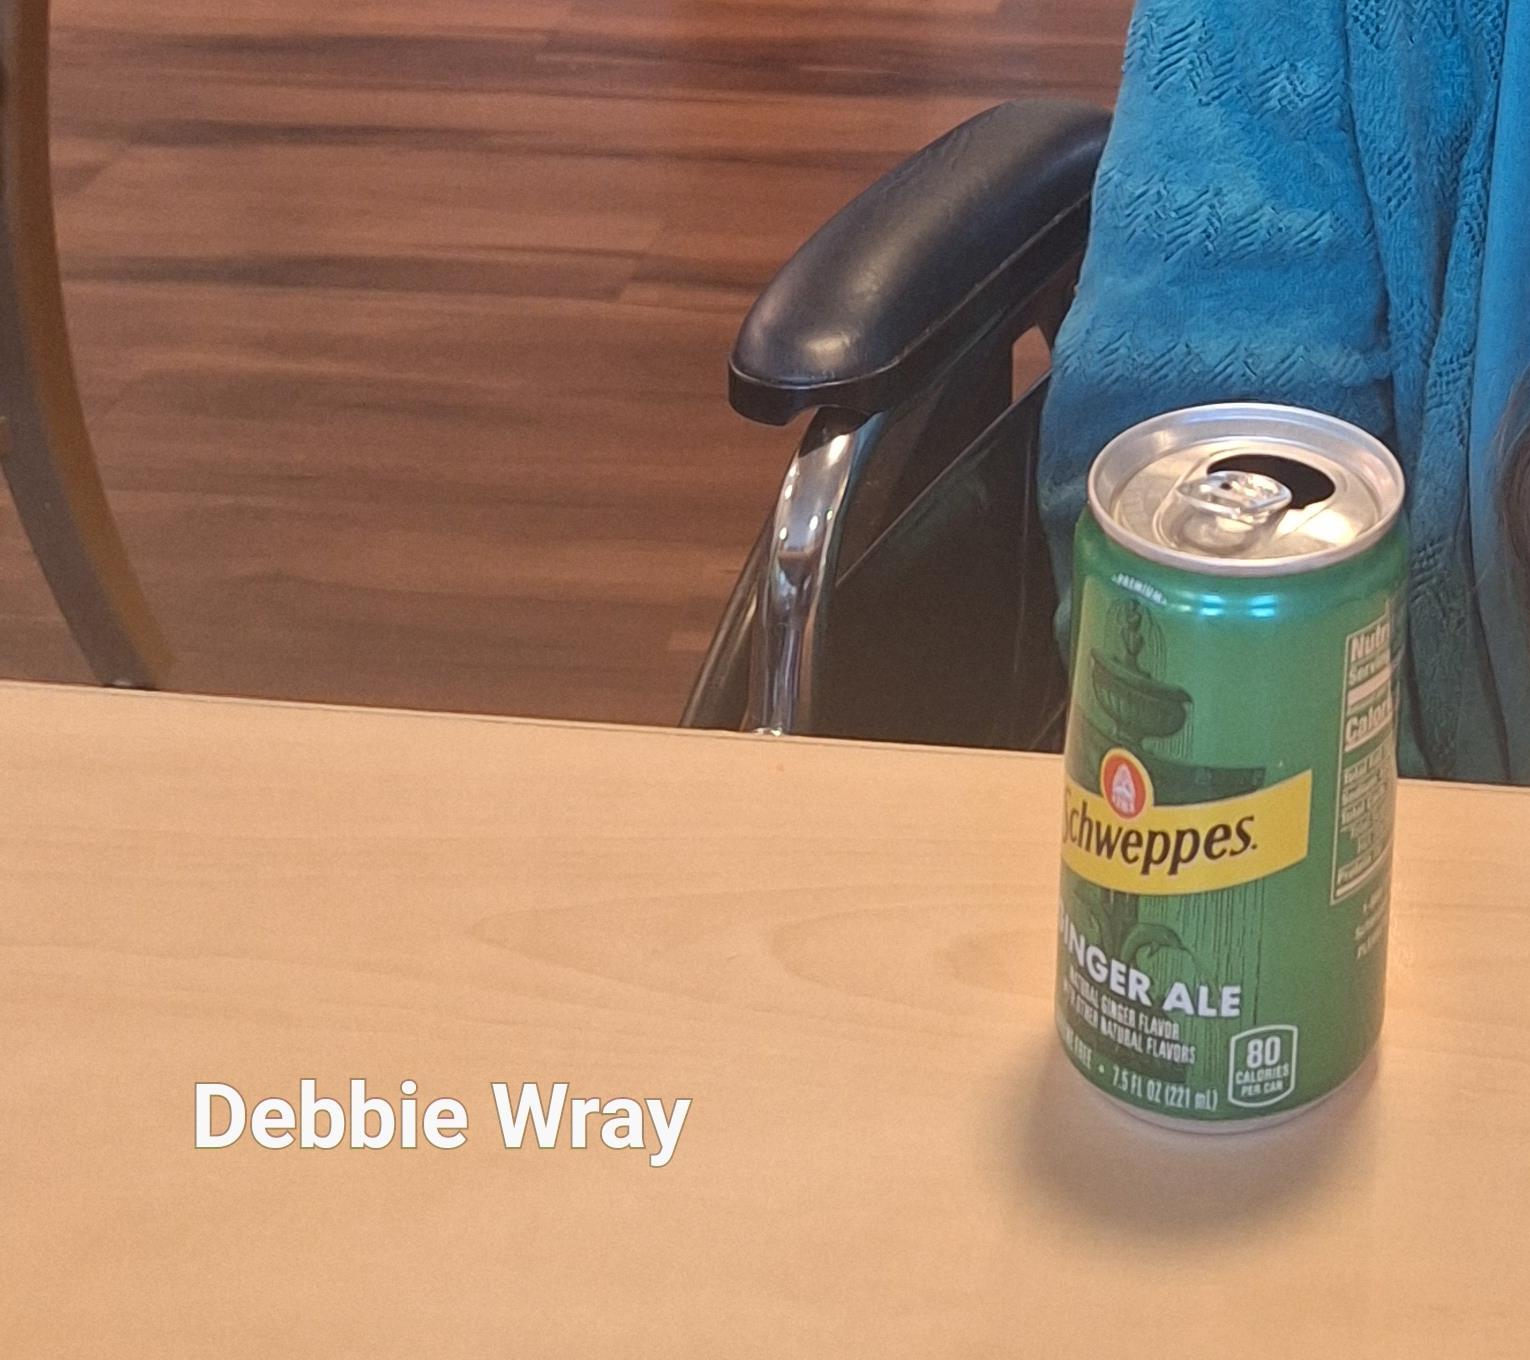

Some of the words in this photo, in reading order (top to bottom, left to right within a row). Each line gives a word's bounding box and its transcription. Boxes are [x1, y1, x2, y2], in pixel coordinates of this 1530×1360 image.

[1060, 902, 1153, 1007] INGER
[1162, 981, 1241, 1018] ALE
[1101, 994, 1136, 1031] GINGER
[1138, 1011, 1180, 1041] FLAVOR
[1101, 1015, 1144, 1054] NATURAL
[1146, 1036, 1196, 1065] FLAVORS
[1246, 1035, 1281, 1069] 80
[1112, 1064, 1129, 1092] 7.5
[1147, 1078, 1162, 1103] OZ
[1235, 1062, 1290, 1085] CALORIES
[1241, 1083, 1262, 1097] PER
